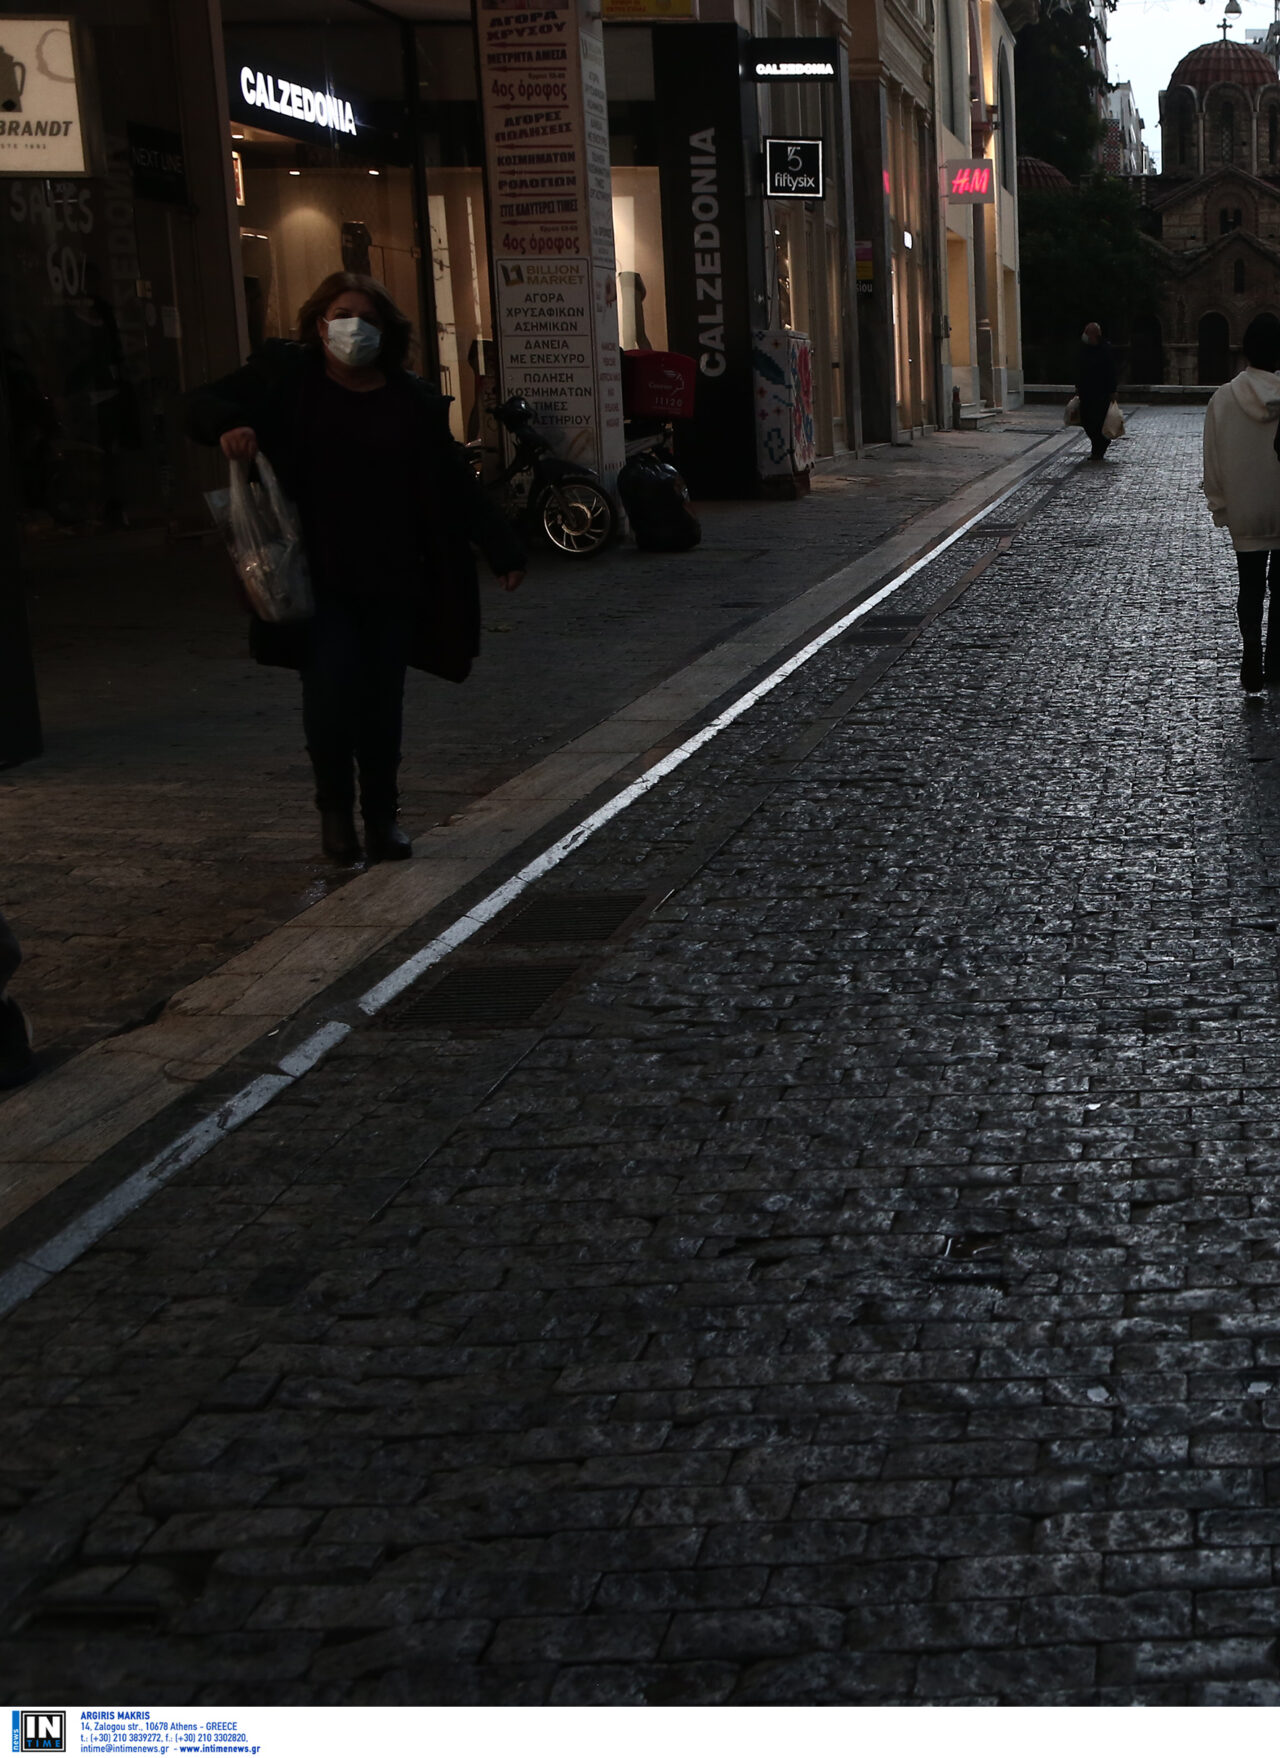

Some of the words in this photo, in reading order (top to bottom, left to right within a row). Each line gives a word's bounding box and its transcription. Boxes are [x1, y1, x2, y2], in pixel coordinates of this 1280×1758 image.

[489, 10, 558, 28] ΑΓΟΡΑ
[487, 51, 534, 65] ΜΕΤΡΗΤΑ
[756, 63, 834, 75] CALZEDONIA
[491, 79, 515, 101] 4ος
[518, 79, 568, 100] όροφος
[240, 66, 357, 136] CALZEDONIA
[504, 111, 562, 127] ΑΓΟΡΕΣ
[775, 172, 815, 191] fiftysix
[10, 180, 94, 234] SALES
[503, 233, 525, 254] 4ος
[529, 233, 579, 254] όροφος
[689, 127, 727, 377] CALZEDONIA
[526, 265, 579, 274] BILLION
[527, 275, 584, 285] MARKET
[524, 293, 565, 303] ΑΓΟΡΑ
[506, 307, 585, 318] ΧΡΥΣΑΦΙΚΩΝ
[514, 321, 578, 332] ΑΣΗΜΙΚΩΝ
[524, 339, 569, 350] ΔΑΝΕΙΑ
[510, 354, 526, 364] ΜΕ
[530, 354, 585, 364] ΕΝΕΧΥΡΟ
[524, 373, 574, 383] ΠΩΛΗΣΗ
[507, 387, 592, 398] ΚΟΣΜΗΜΑΤΩΝ
[533, 401, 568, 411] ΤΙΜΕΣ
